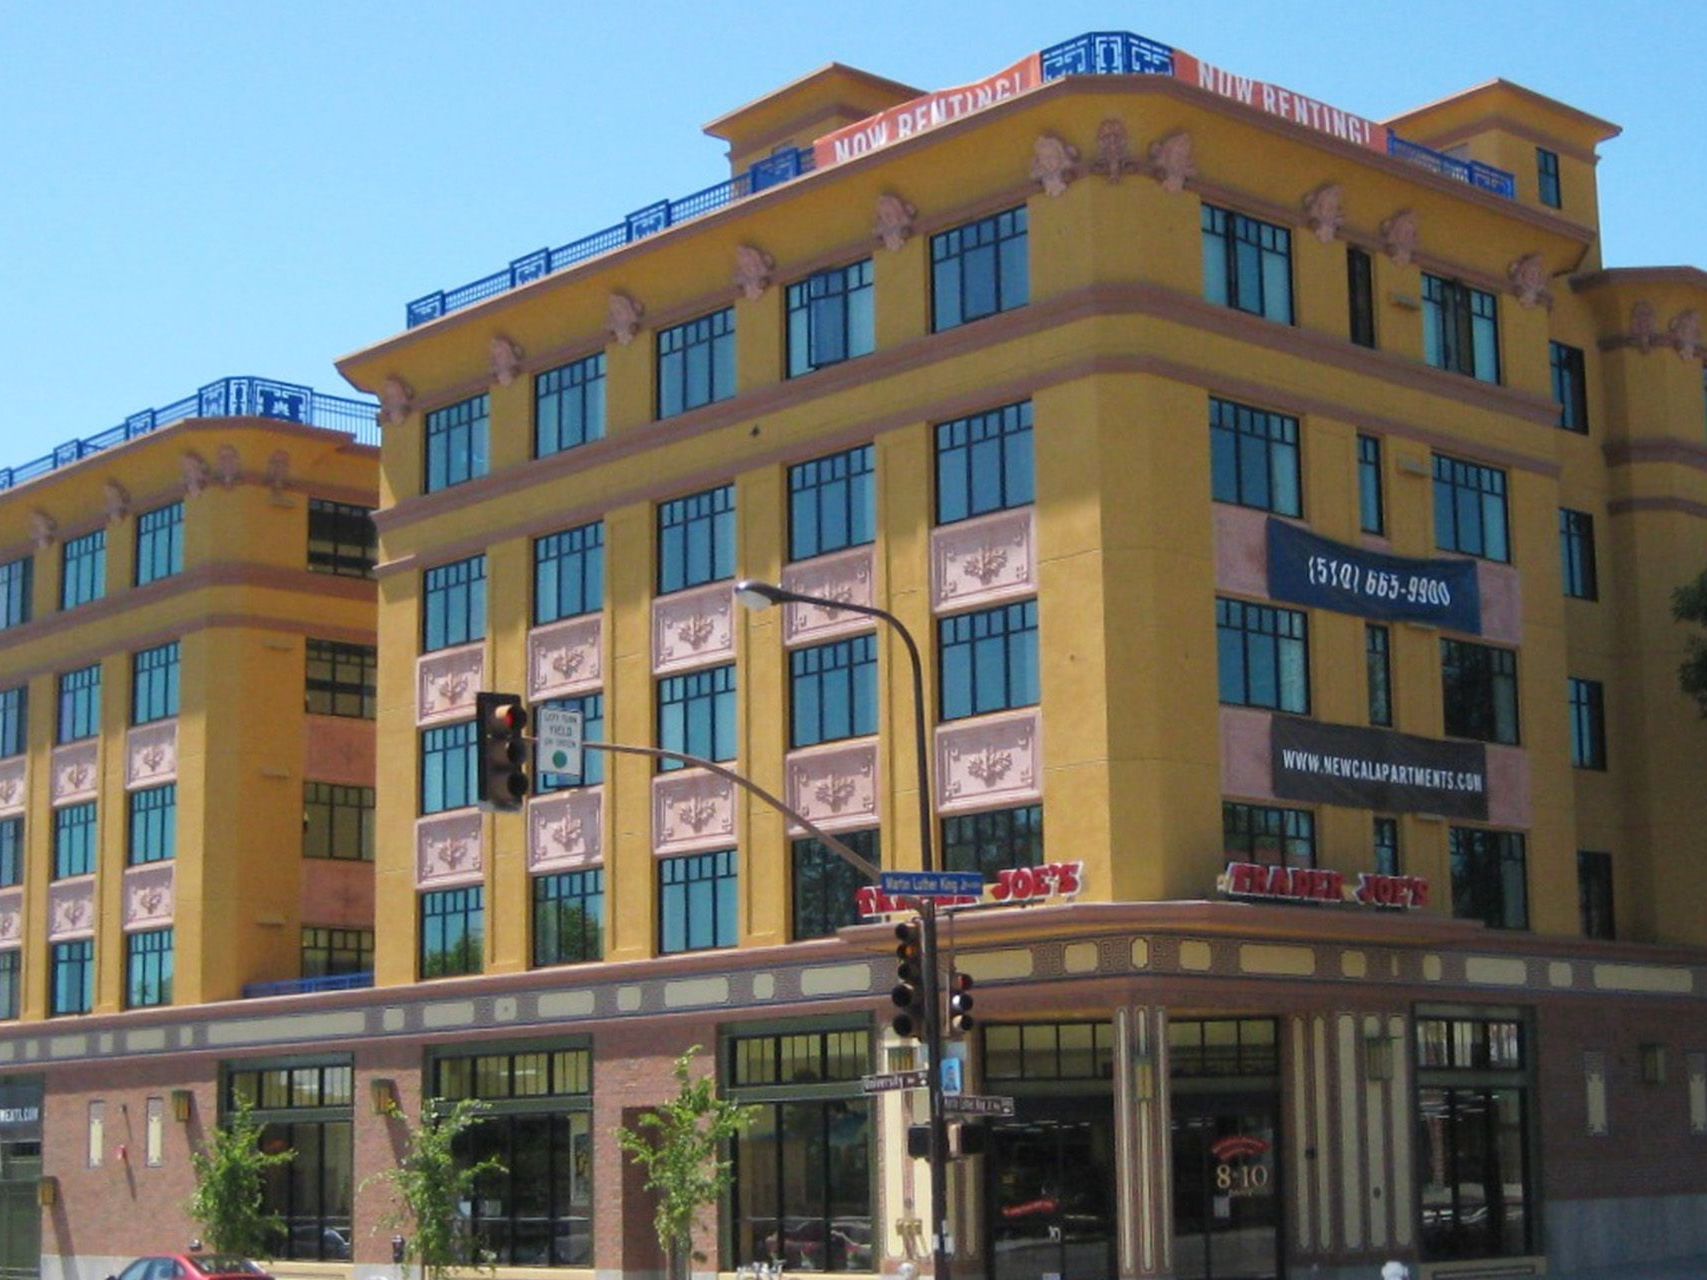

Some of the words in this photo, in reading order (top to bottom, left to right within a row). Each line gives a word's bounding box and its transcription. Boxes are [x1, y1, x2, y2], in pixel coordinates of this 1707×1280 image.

[834, 119, 888, 165] NOW
[896, 71, 1021, 140] RENTING!
[1197, 59, 1254, 105] NOW
[1261, 83, 1371, 145] RENTING!
[1308, 555, 1360, 594] (510)
[1365, 570, 1452, 607] 665-9900
[549, 725, 572, 738] YIELD
[1282, 748, 1483, 793] WWW.NEWCALAPARTMENTS.COM
[991, 860, 1084, 901] JOE'S
[1228, 862, 1347, 904] TRADER
[1353, 872, 1434, 910] JOE'S
